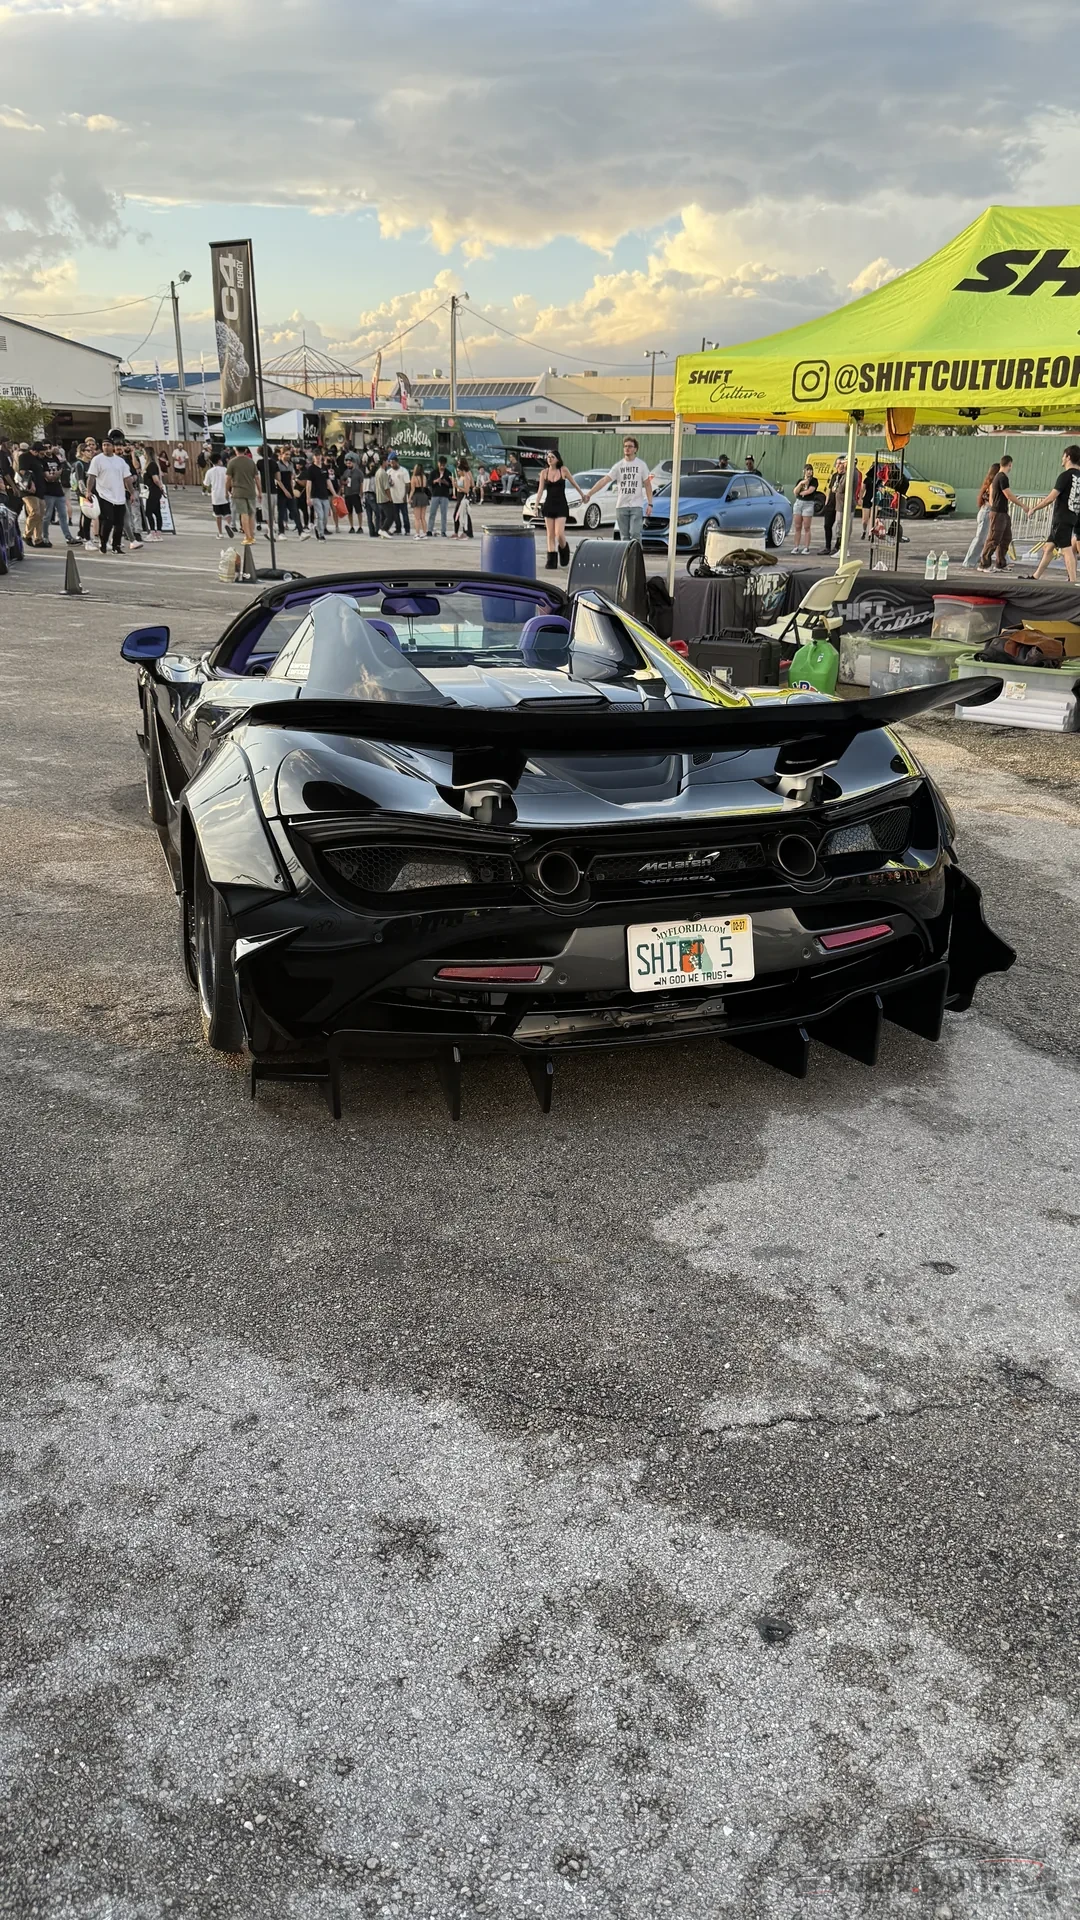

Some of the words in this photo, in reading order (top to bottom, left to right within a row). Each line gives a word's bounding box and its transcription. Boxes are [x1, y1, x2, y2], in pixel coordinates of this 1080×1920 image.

[236, 260, 245, 289] ENERGY
[219, 253, 239, 321] C4
[688, 369, 734, 385] SHIFT
[709, 383, 767, 403] Culture
[620, 466, 639, 474] WHITE
[628, 480, 638, 488] THE
[827, 601, 887, 621] HIFT
[638, 858, 712, 872] McLaren
[656, 924, 727, 940] MYFLORIDA.COM
[720, 936, 733, 968] 5
[659, 977, 667, 986] IN
[669, 974, 686, 985] GOD
[688, 973, 699, 982] WE
[702, 970, 728, 981] TRUST
